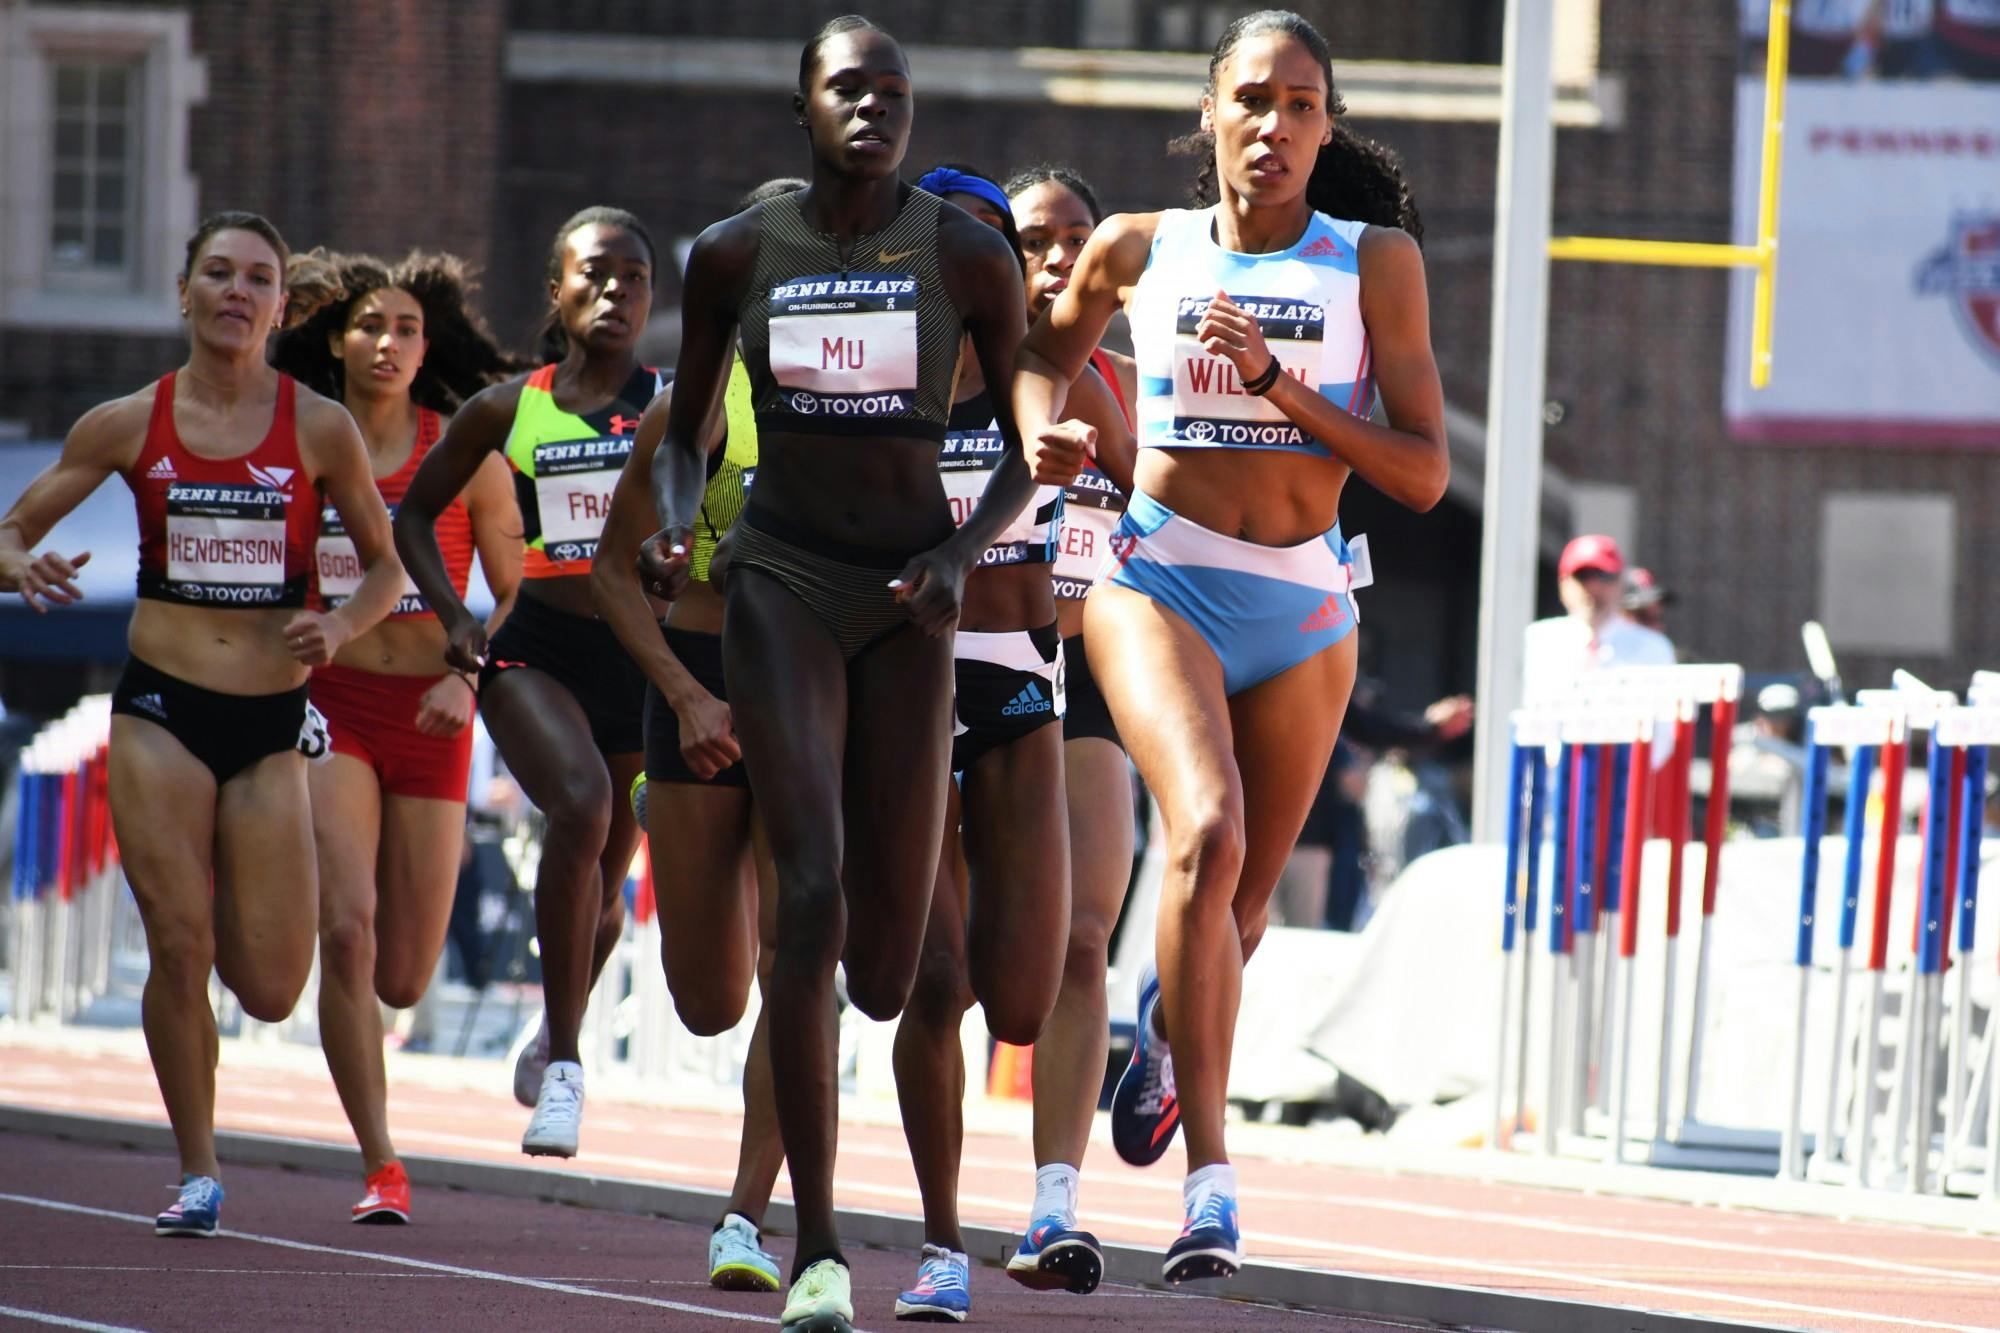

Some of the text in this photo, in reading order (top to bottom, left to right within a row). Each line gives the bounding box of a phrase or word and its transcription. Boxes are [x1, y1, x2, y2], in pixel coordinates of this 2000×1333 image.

[771, 279, 916, 300] PENN RELAYS
[788, 302, 856, 311] ON-RUNNING.COM
[1247, 303, 1323, 321] RELAYS
[821, 336, 865, 370] MU
[1187, 358, 1307, 396] WILN
[820, 394, 905, 414] TOYOTA
[1219, 424, 1304, 445] TOYOTA
[534, 443, 583, 462] PENN
[960, 437, 1004, 453] REL
[167, 487, 218, 501] PENN
[170, 533, 283, 565] HENDERSON
[977, 545, 1020, 564] OTA
[319, 551, 364, 580] GOR
[206, 587, 273, 602] TOYOTA
[1002, 699, 1051, 716] adidas
